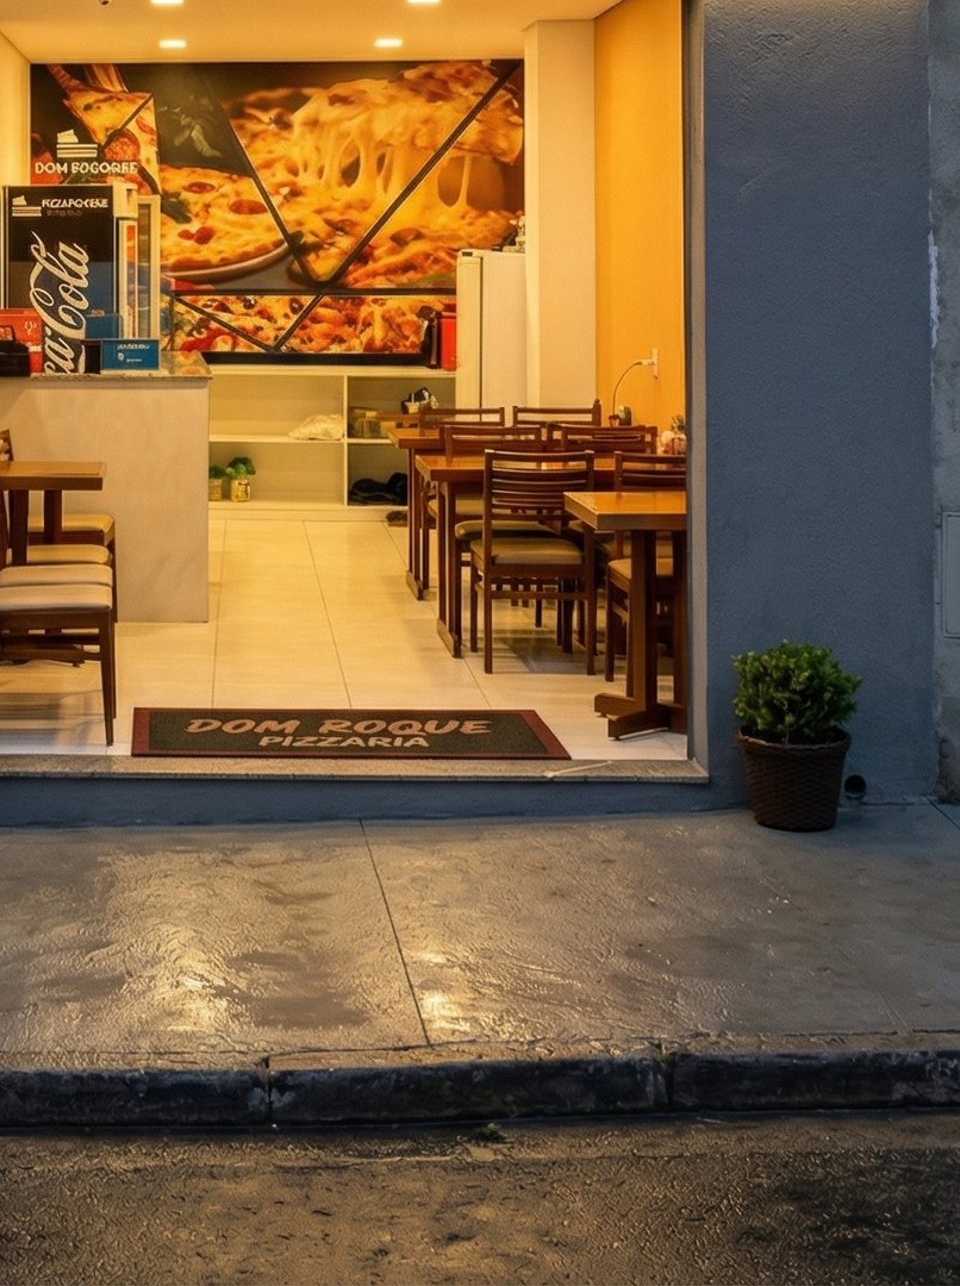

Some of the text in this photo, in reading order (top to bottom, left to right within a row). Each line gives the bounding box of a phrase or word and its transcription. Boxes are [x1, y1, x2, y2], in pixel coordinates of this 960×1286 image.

[35, 162, 68, 174] DOM
[184, 718, 493, 736] DOM ROQUE
[258, 735, 430, 748] PIZZARIA
